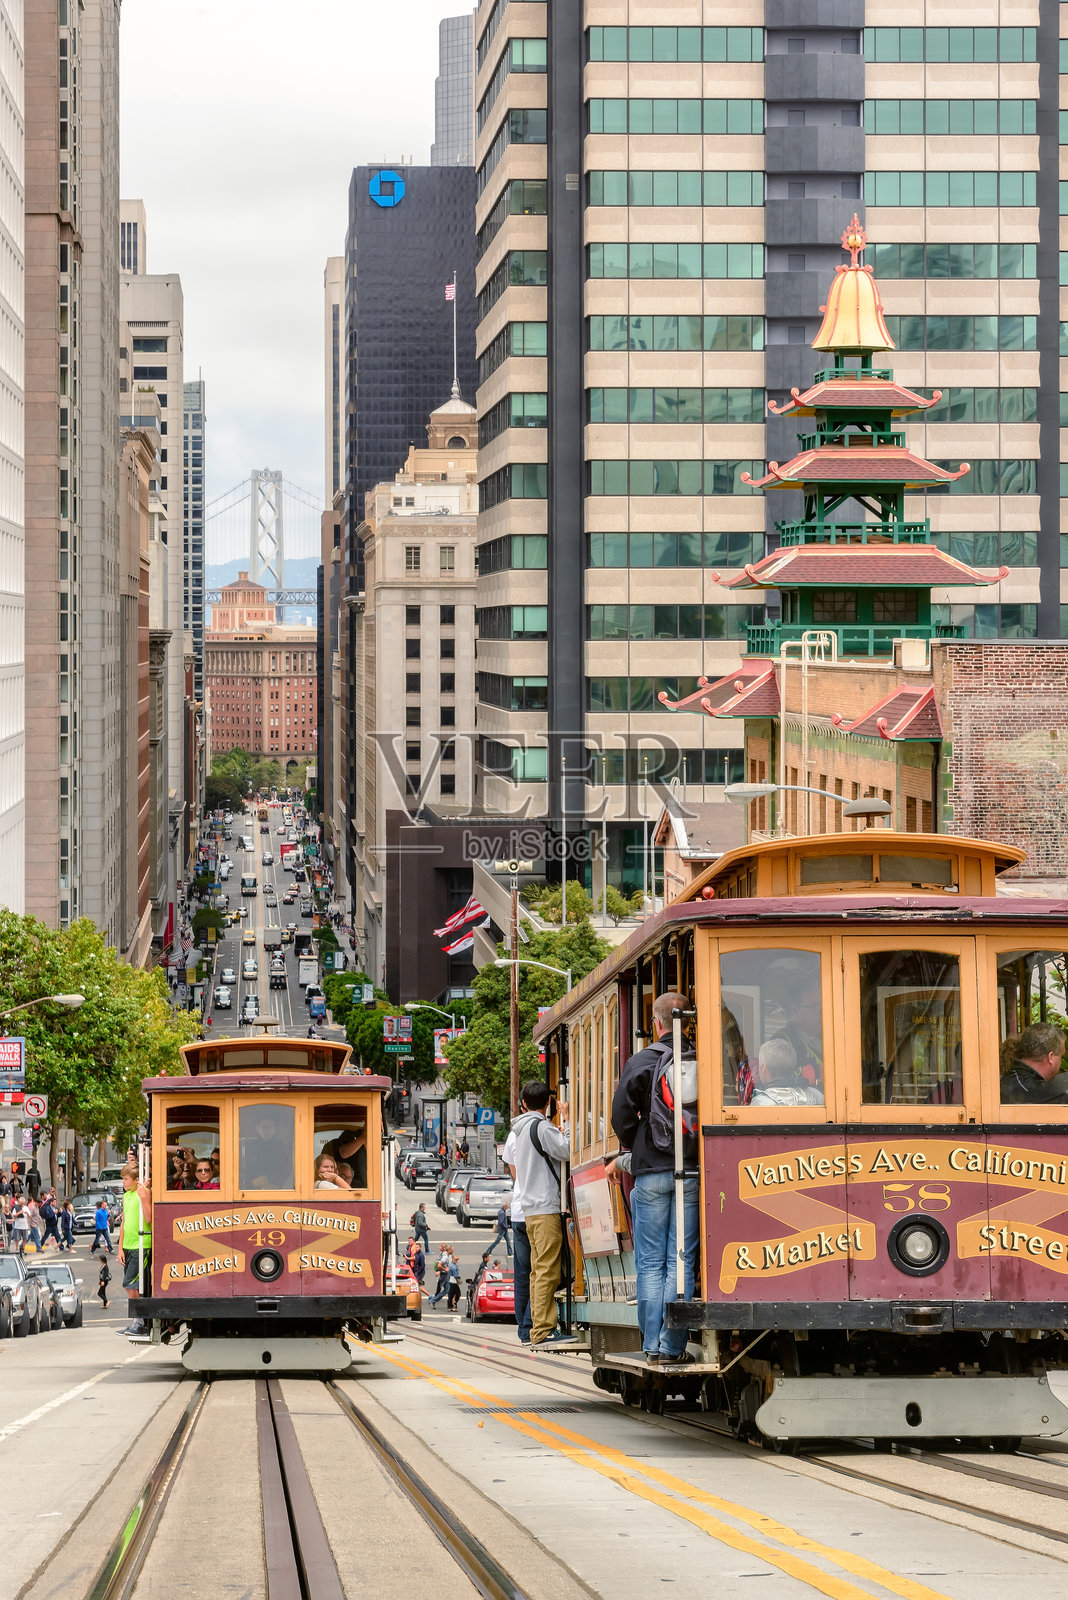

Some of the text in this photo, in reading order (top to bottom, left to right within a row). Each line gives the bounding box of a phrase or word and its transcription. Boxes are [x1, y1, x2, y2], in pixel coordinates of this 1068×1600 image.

[744, 1162, 794, 1188] Van
[795, 1154, 863, 1181] Ness
[948, 1148, 1067, 1185] Californi
[882, 1183, 951, 1212] 58
[176, 1218, 202, 1234] Van
[204, 1212, 241, 1229] Ness
[283, 1210, 358, 1233] California
[247, 1230, 286, 1247] 49
[735, 1245, 757, 1270] &
[761, 1227, 863, 1270] Market
[169, 1254, 363, 1278] & Market Streets
